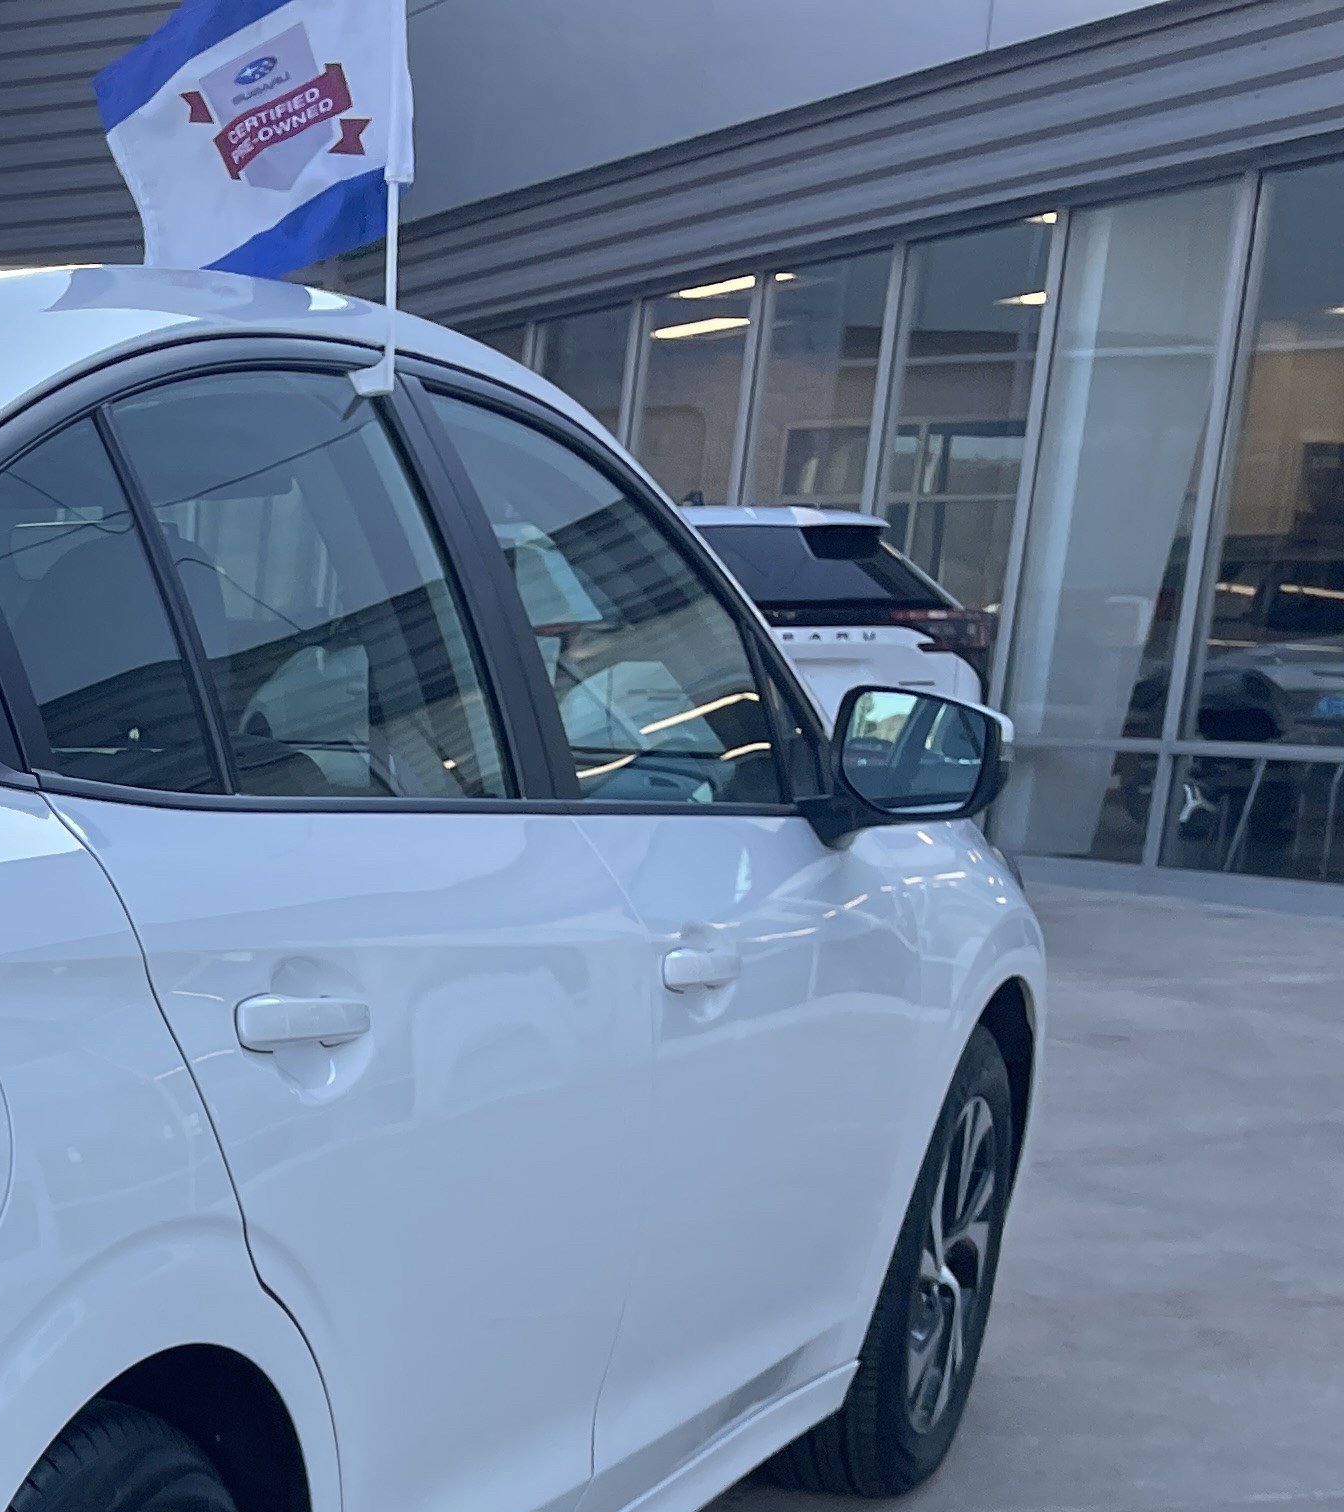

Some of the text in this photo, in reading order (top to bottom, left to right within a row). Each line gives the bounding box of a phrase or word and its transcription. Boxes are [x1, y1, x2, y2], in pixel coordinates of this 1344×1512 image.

[227, 87, 320, 145] CERTIFIED
[231, 97, 333, 165] PRE-OWNED
[782, 631, 877, 642] BARU
